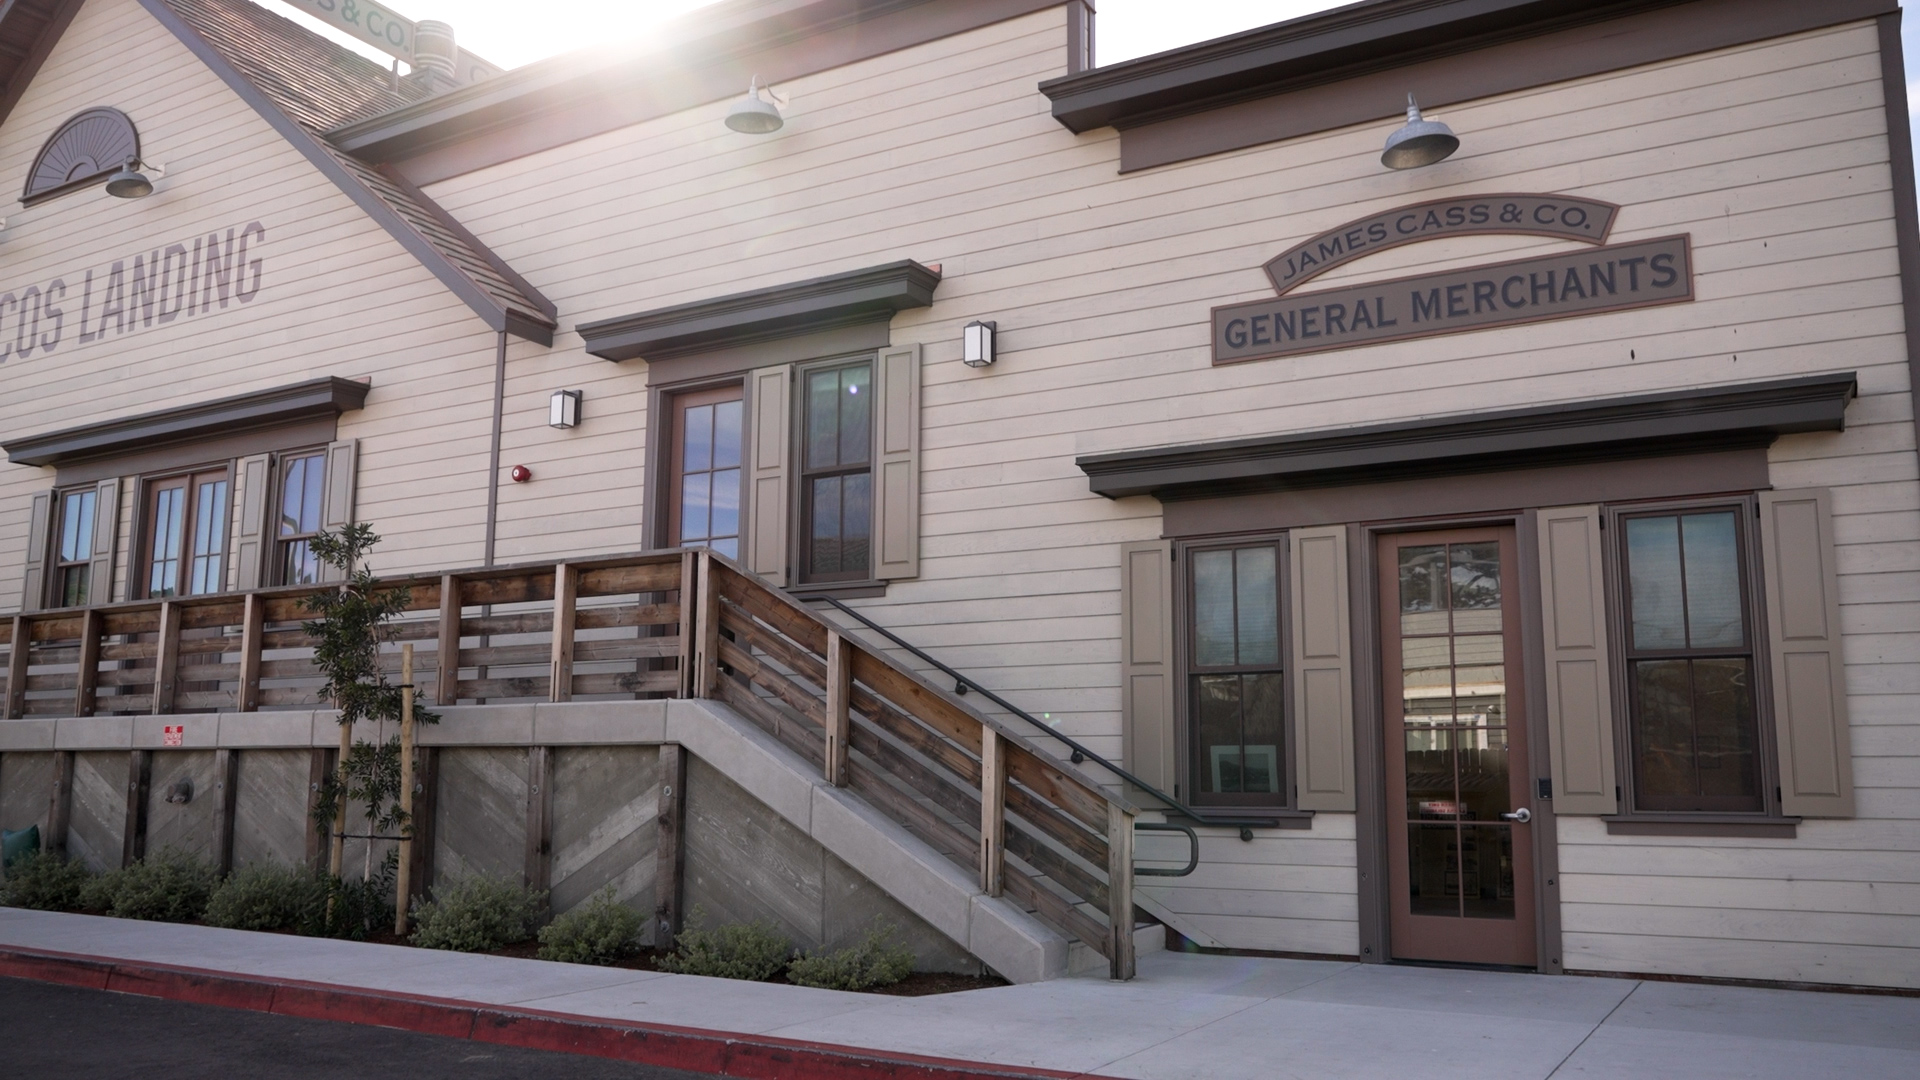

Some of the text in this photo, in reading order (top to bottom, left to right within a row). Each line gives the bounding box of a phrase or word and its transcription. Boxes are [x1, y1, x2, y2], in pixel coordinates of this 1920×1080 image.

[341, 0, 410, 53] & CO.
[79, 220, 266, 345] LANDING
[1283, 202, 1591, 281] JAMES CASS & CO.
[1224, 253, 1679, 349] GENERAL MERCHANTS
